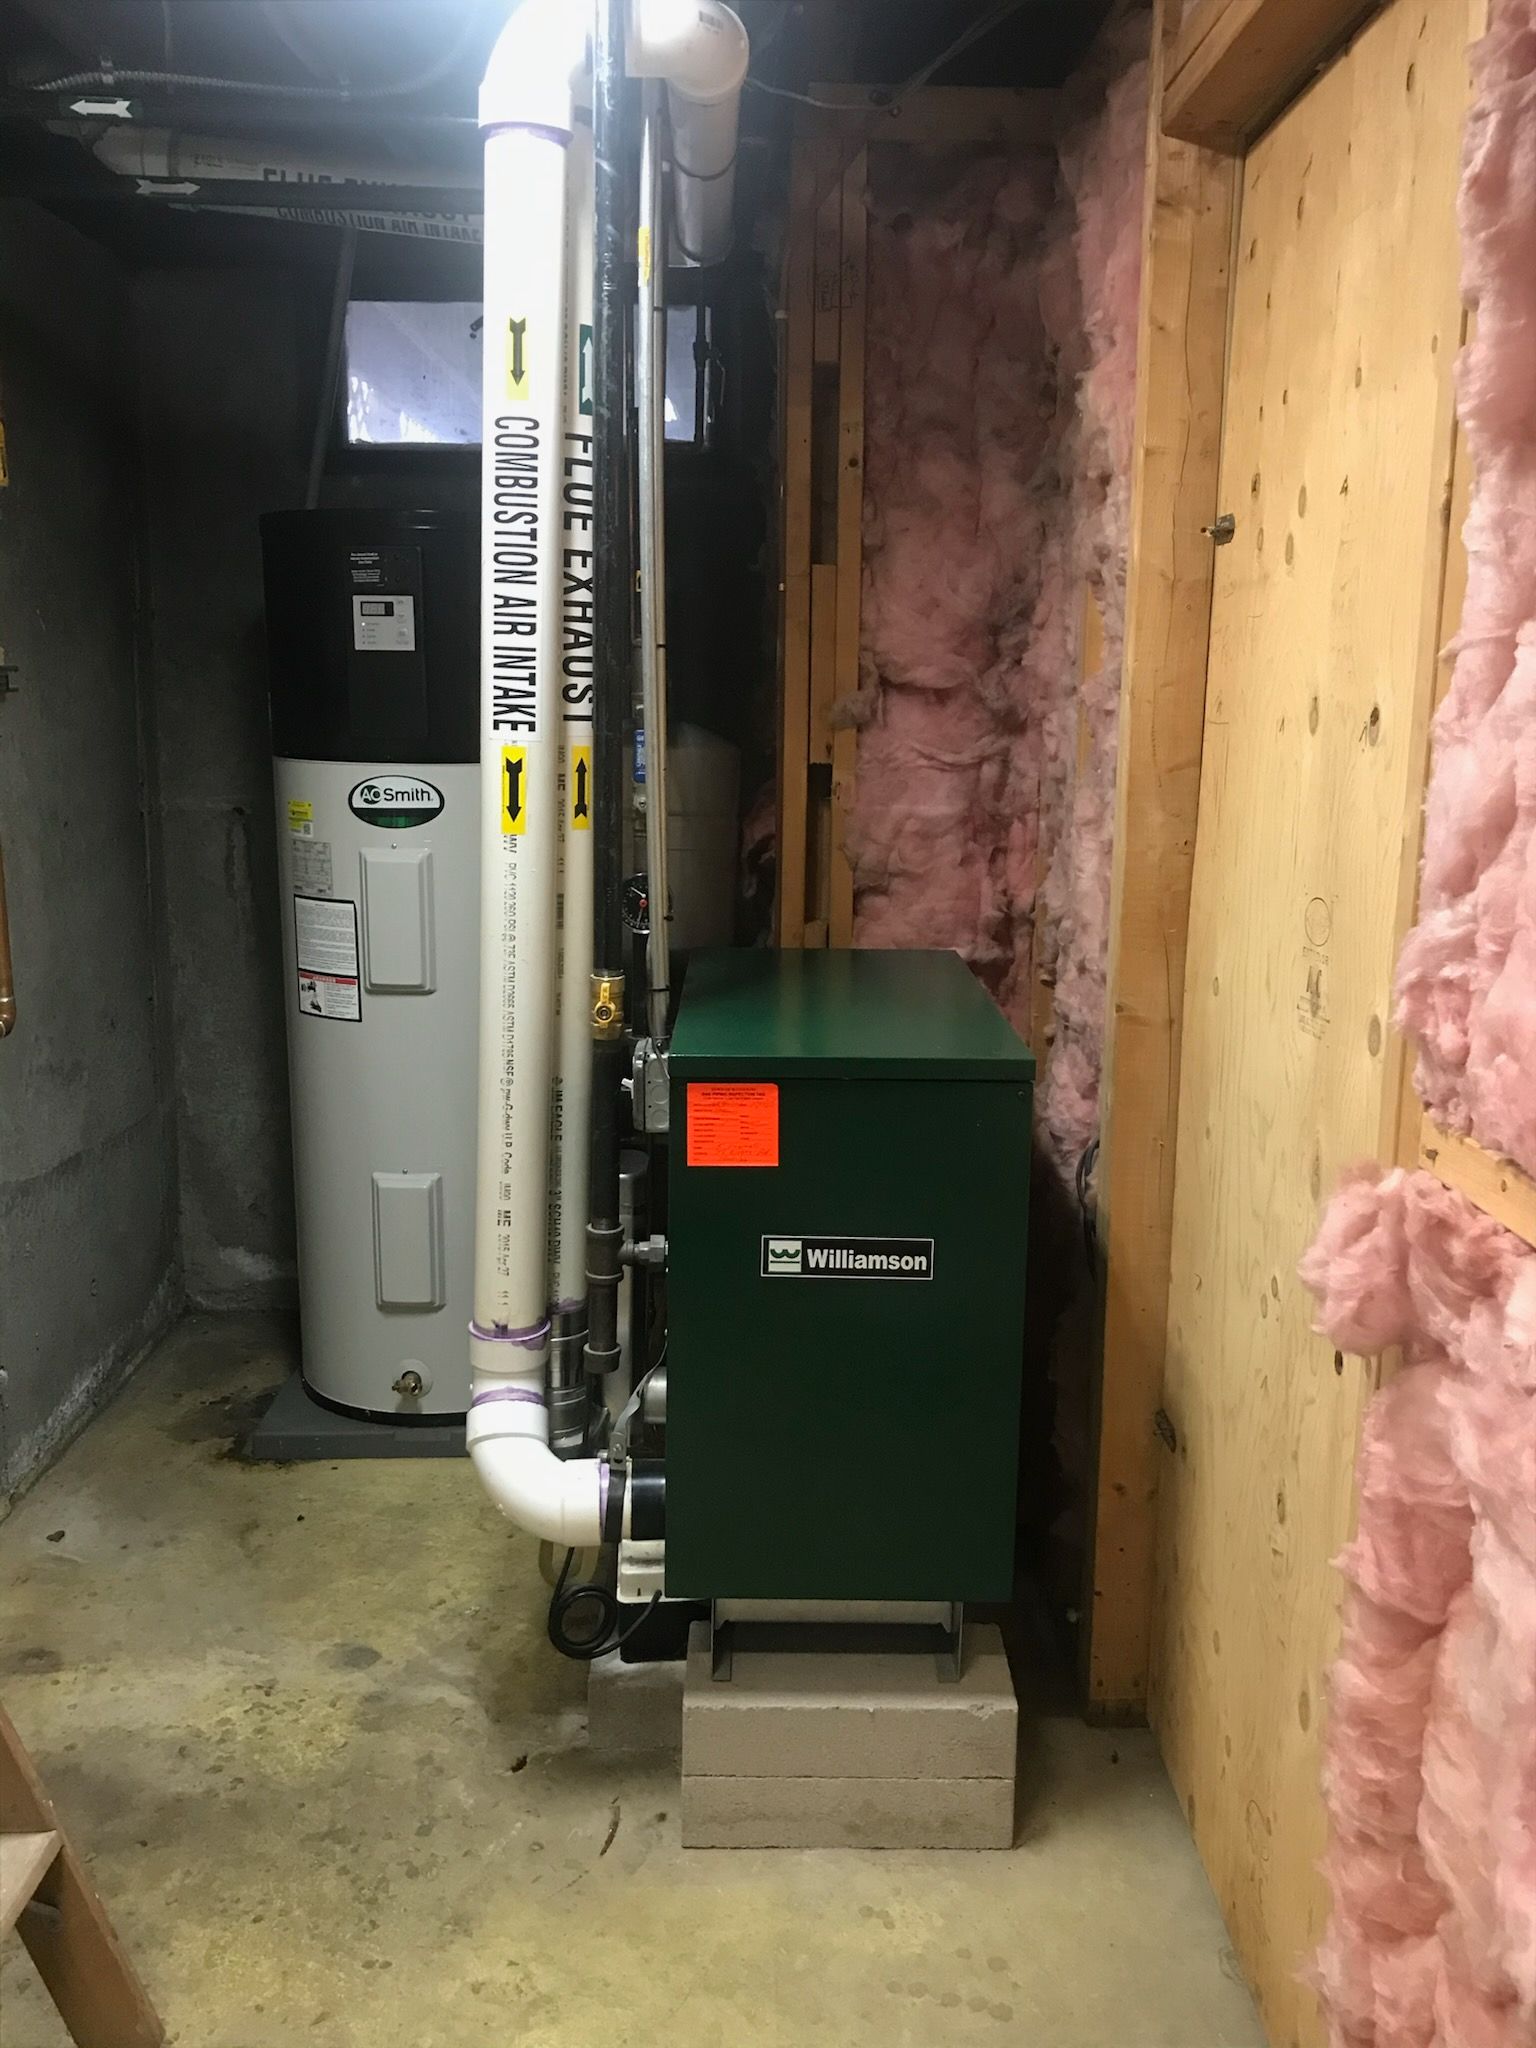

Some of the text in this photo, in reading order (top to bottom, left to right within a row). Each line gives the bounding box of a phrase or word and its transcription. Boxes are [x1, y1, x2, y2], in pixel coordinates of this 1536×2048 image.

[563, 433, 593, 531] FLUE
[493, 416, 540, 732] COMBUSTION AIR INTAKE
[383, 787, 431, 803] Smith
[502, 960, 517, 984] ASTM
[806, 1248, 928, 1271] Williamson
